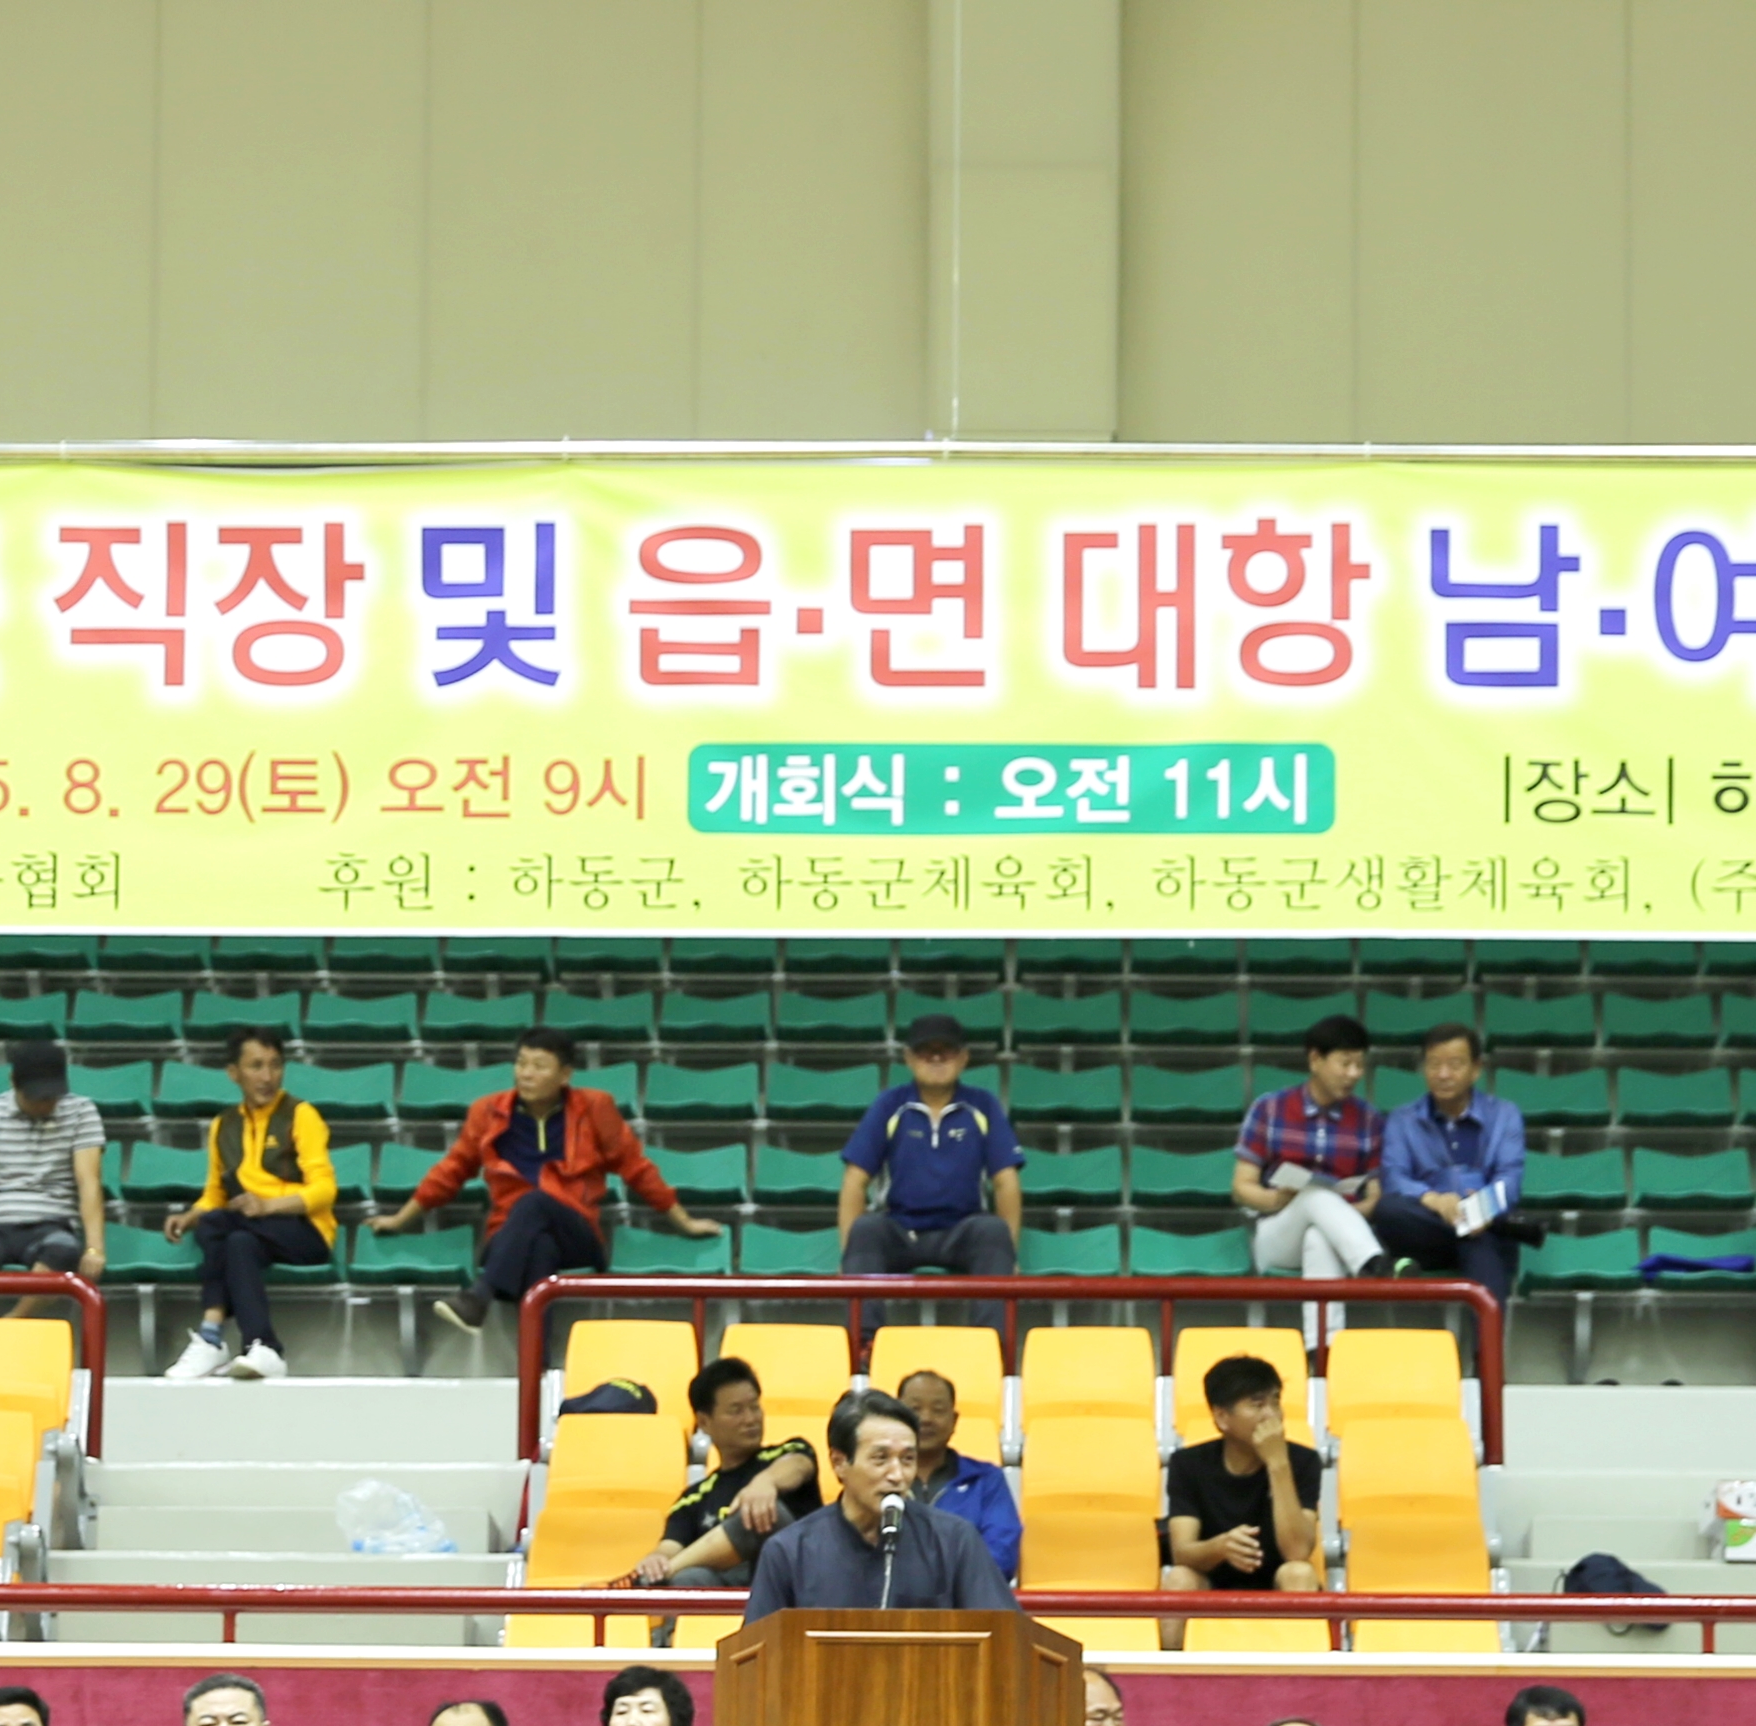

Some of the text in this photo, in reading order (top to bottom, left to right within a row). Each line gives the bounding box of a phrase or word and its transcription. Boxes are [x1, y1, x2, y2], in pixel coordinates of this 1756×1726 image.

[54, 522, 366, 688] 직장
[421, 522, 561, 688] 및
[1062, 518, 1371, 690] 대항
[63, 757, 121, 819] 8.
[155, 751, 351, 821] 29(토)
[380, 753, 512, 821] 오전
[543, 753, 646, 821] 9시
[704, 752, 907, 827] 개회식
[993, 754, 1132, 825] 오전
[1163, 752, 1309, 826] 11시
[317, 852, 436, 912] 후원
[509, 852, 702, 912] 하동군,
[738, 853, 1116, 913] 하동군체육회,
[1152, 853, 1654, 914] 하동군생활체육회,
